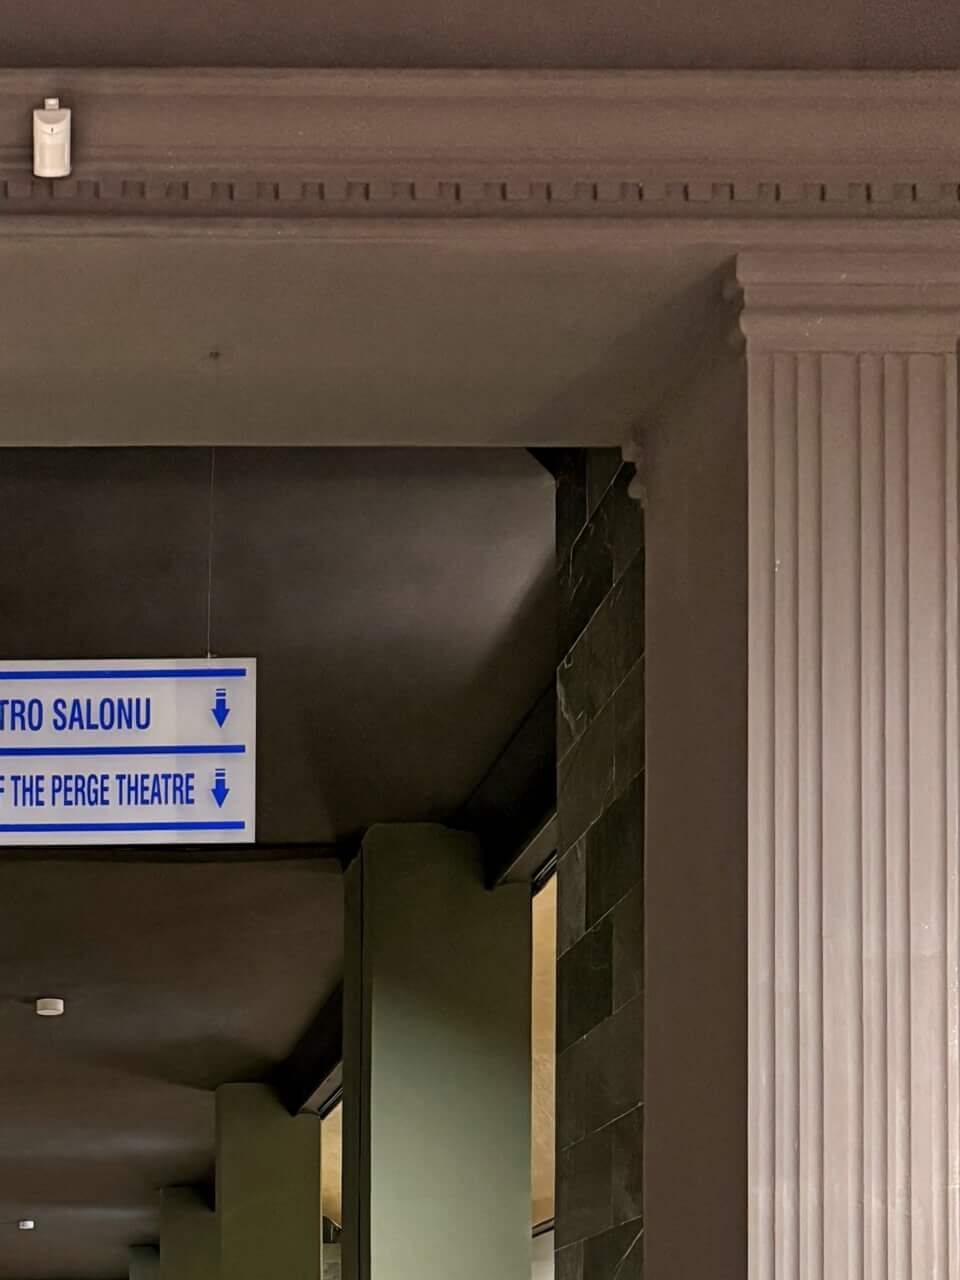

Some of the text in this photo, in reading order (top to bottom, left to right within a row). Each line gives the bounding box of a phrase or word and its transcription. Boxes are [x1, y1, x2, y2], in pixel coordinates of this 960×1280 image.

[52, 697, 151, 731] SALONU
[10, 774, 45, 807] THE
[51, 773, 110, 807] PERGE
[115, 772, 195, 806] THEATRE
